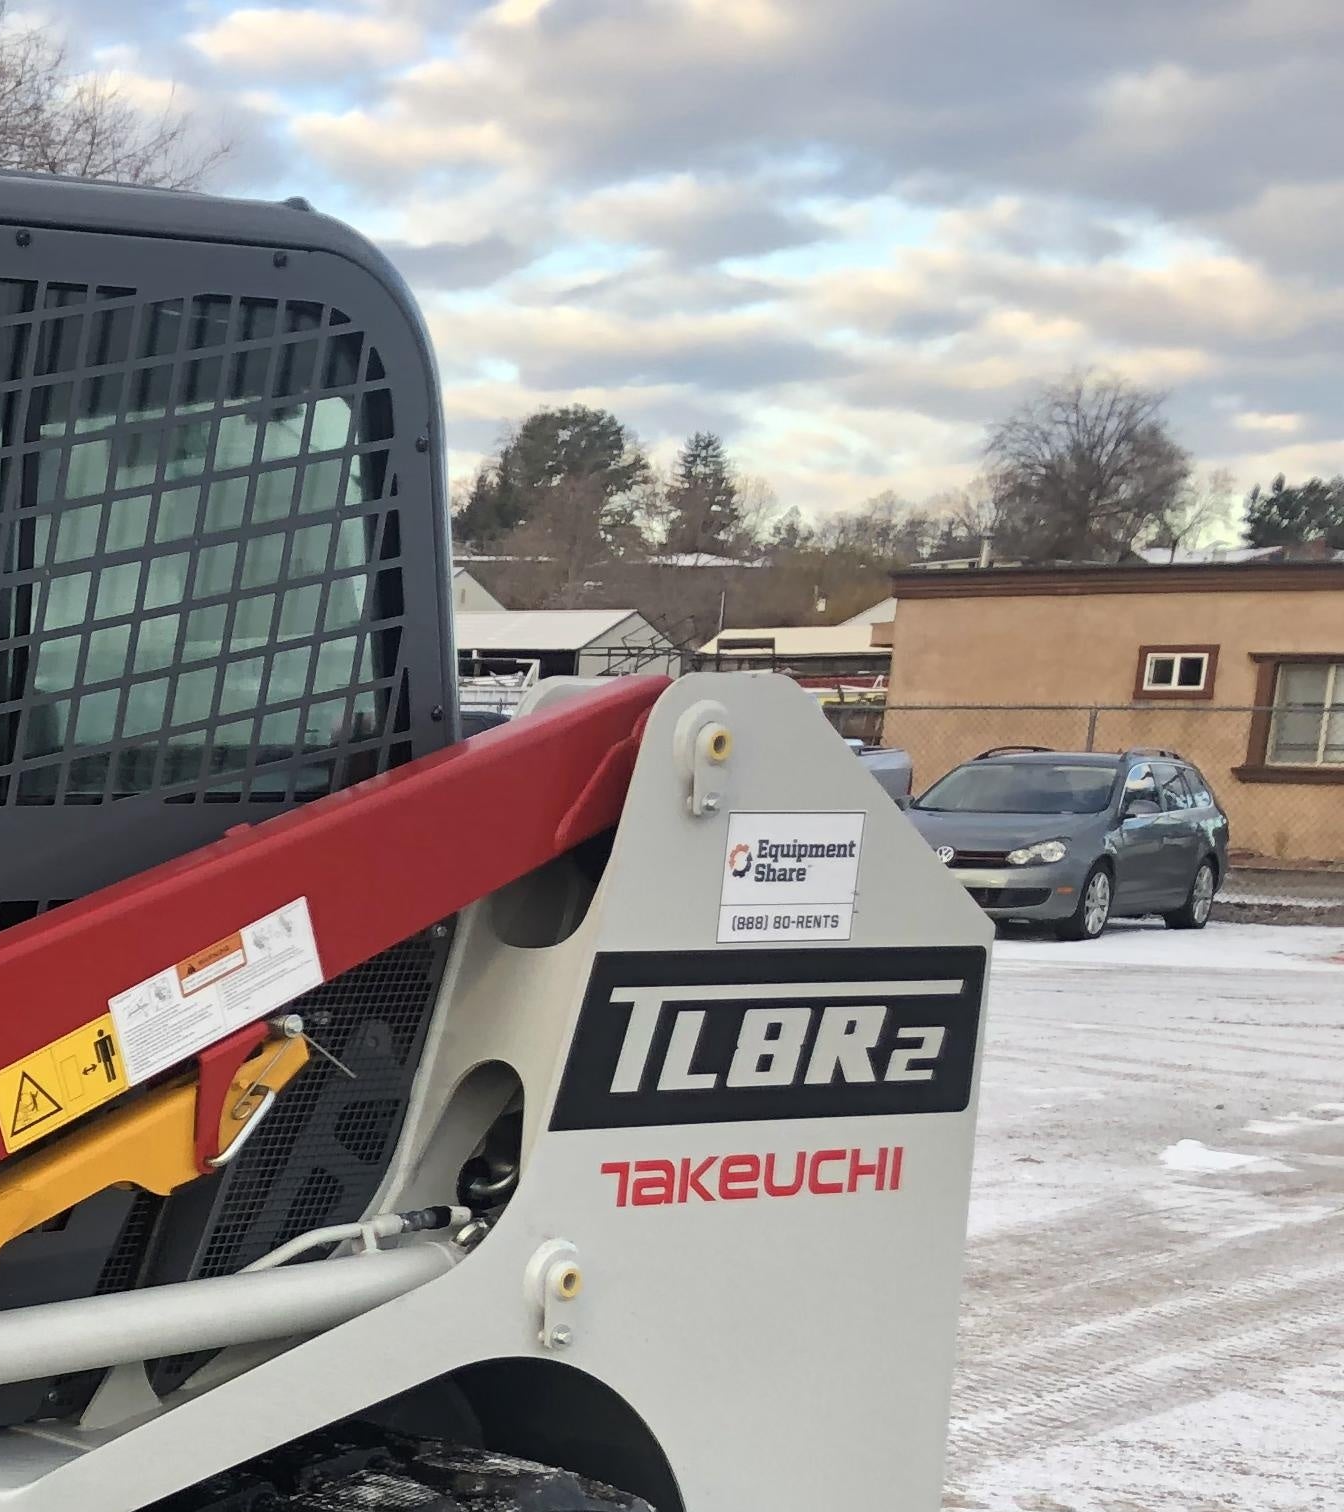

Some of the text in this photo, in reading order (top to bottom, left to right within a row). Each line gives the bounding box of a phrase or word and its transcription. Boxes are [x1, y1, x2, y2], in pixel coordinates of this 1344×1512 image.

[756, 838, 856, 862] Equipment
[753, 862, 807, 882] Share
[731, 914, 840, 931] (888) 80-RENTS
[608, 978, 964, 1094] TL8R2
[600, 1146, 904, 1207] TAKEUCHI
